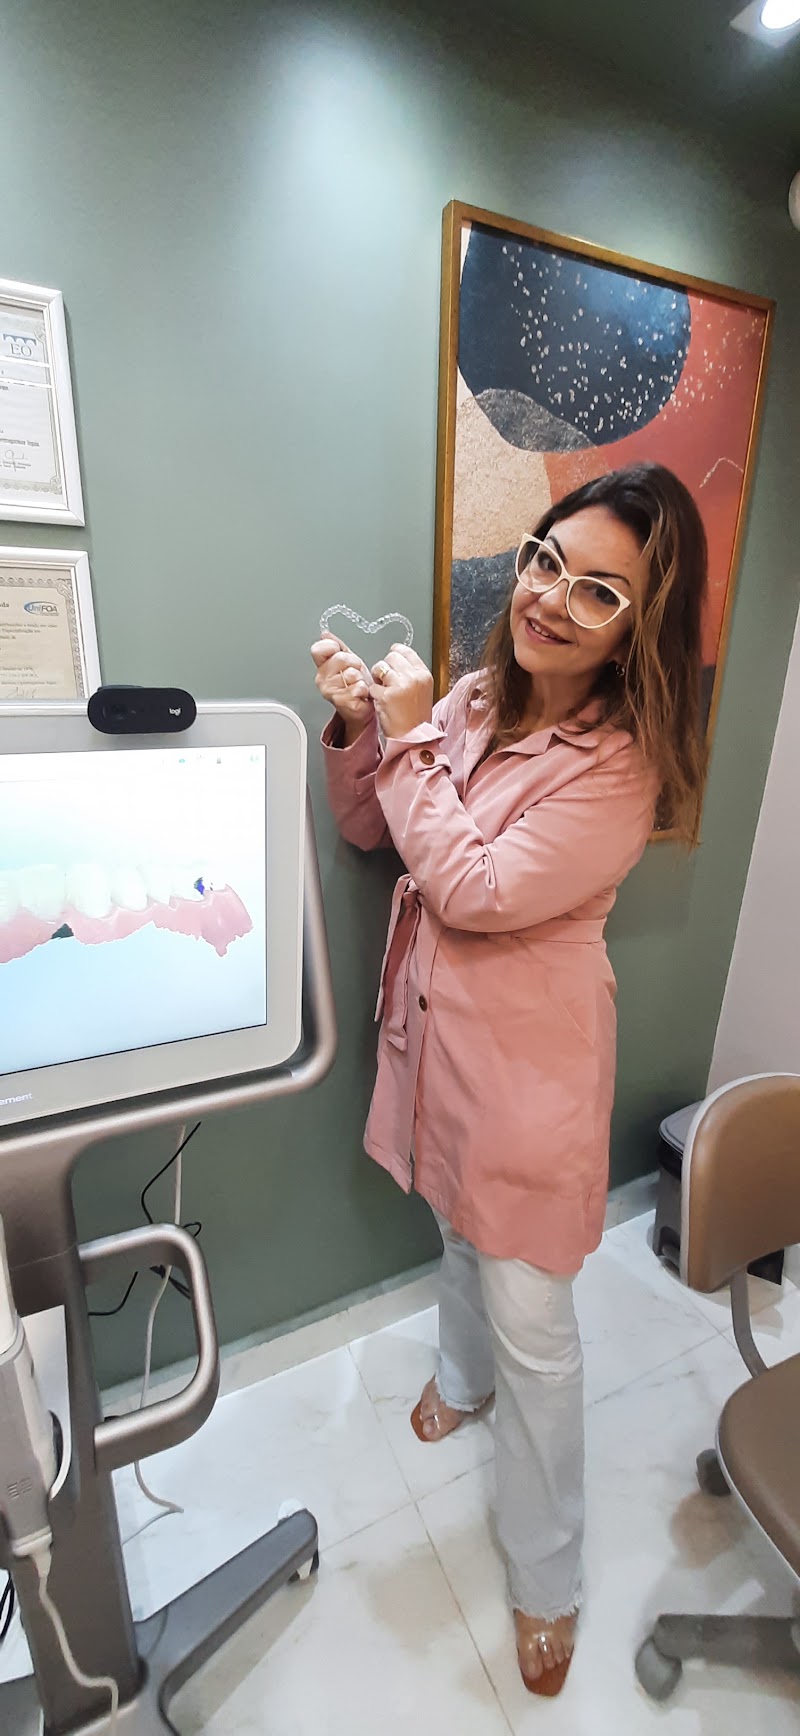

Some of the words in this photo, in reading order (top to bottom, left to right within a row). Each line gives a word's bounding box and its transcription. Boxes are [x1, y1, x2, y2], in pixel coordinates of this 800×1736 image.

[10, 343, 32, 357] EO
[28, 604, 58, 612] UniFOA
[169, 708, 181, 716] logi
